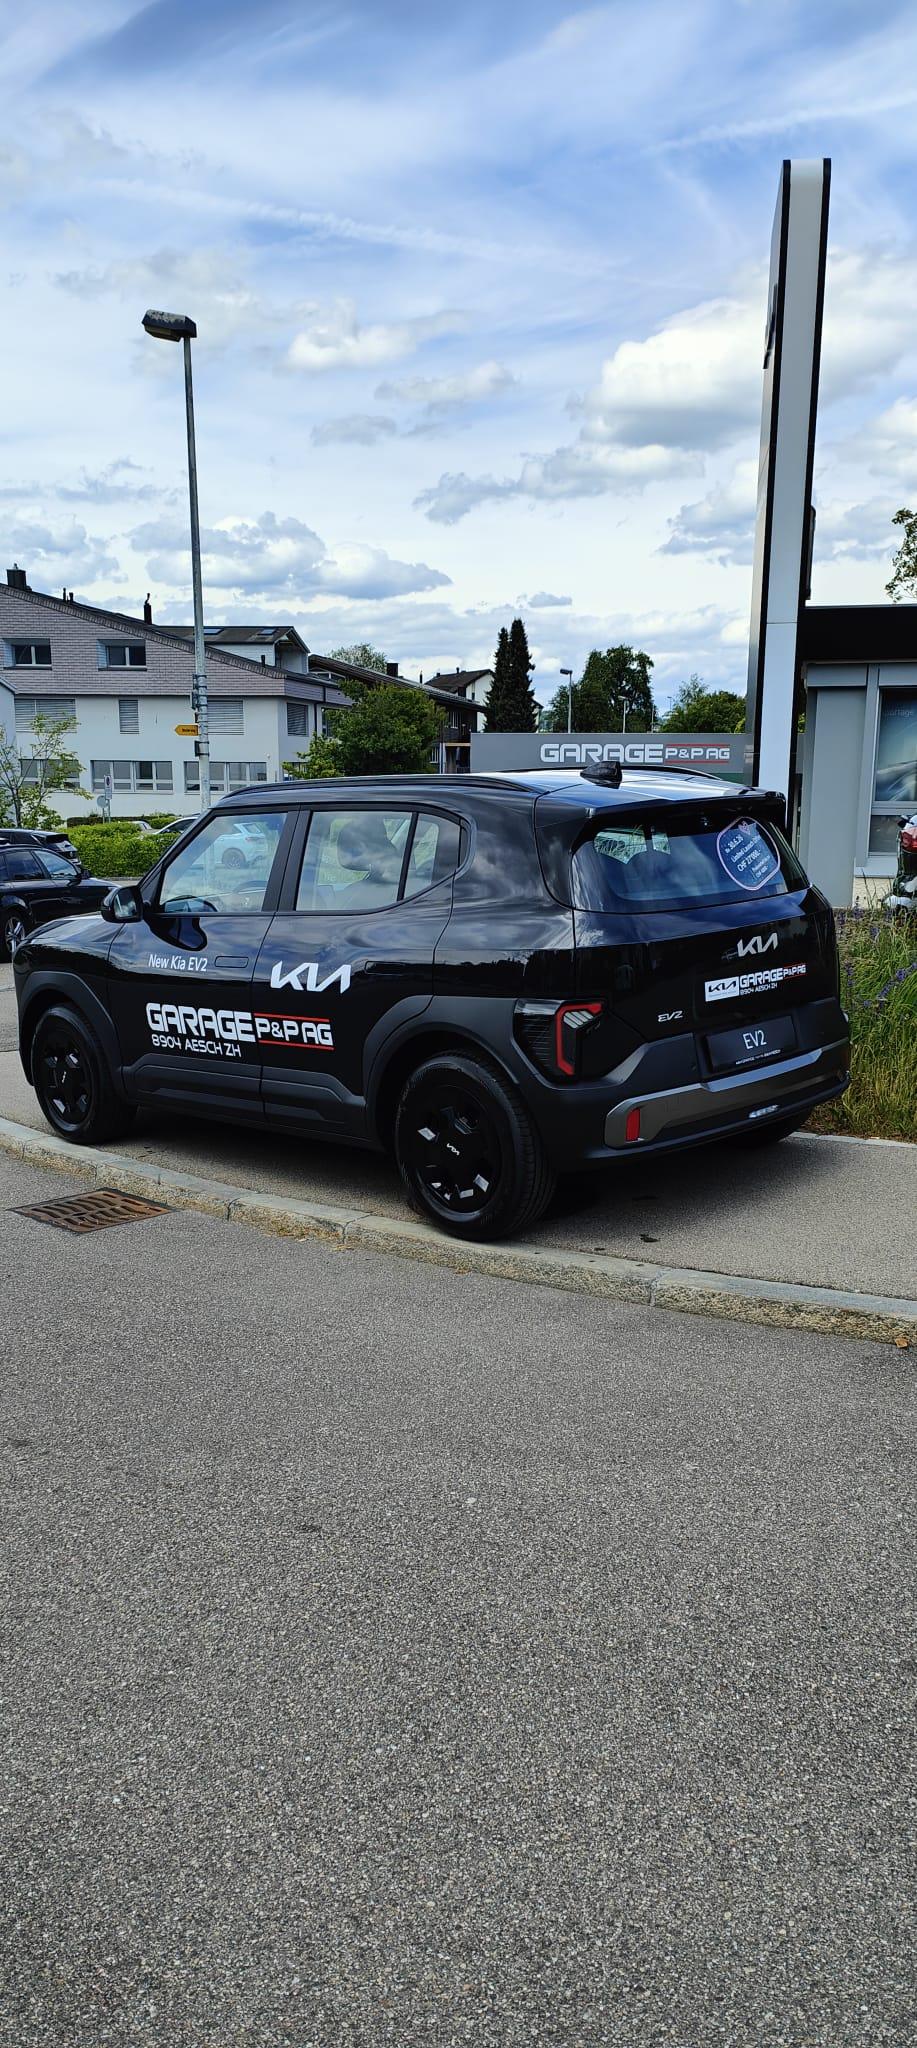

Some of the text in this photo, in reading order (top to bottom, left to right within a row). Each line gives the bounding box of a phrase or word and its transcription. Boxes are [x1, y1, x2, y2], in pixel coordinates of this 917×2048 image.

[540, 743, 730, 763] GARAGE P&P AG
[737, 859, 747, 871] CHF
[737, 932, 779, 957] KIA
[148, 954, 208, 972] New Kia EV2
[270, 960, 352, 994] KIA
[708, 980, 737, 993] KIA
[740, 967, 784, 988] GARAGE
[740, 988, 754, 996] 8904
[754, 983, 771, 993] AESCH
[146, 1002, 334, 1046] GARAGE P&P AG
[657, 1010, 683, 1023] EV2
[151, 1034, 242, 1058] 8904 AESCH ZH
[742, 1029, 767, 1050] EV2
